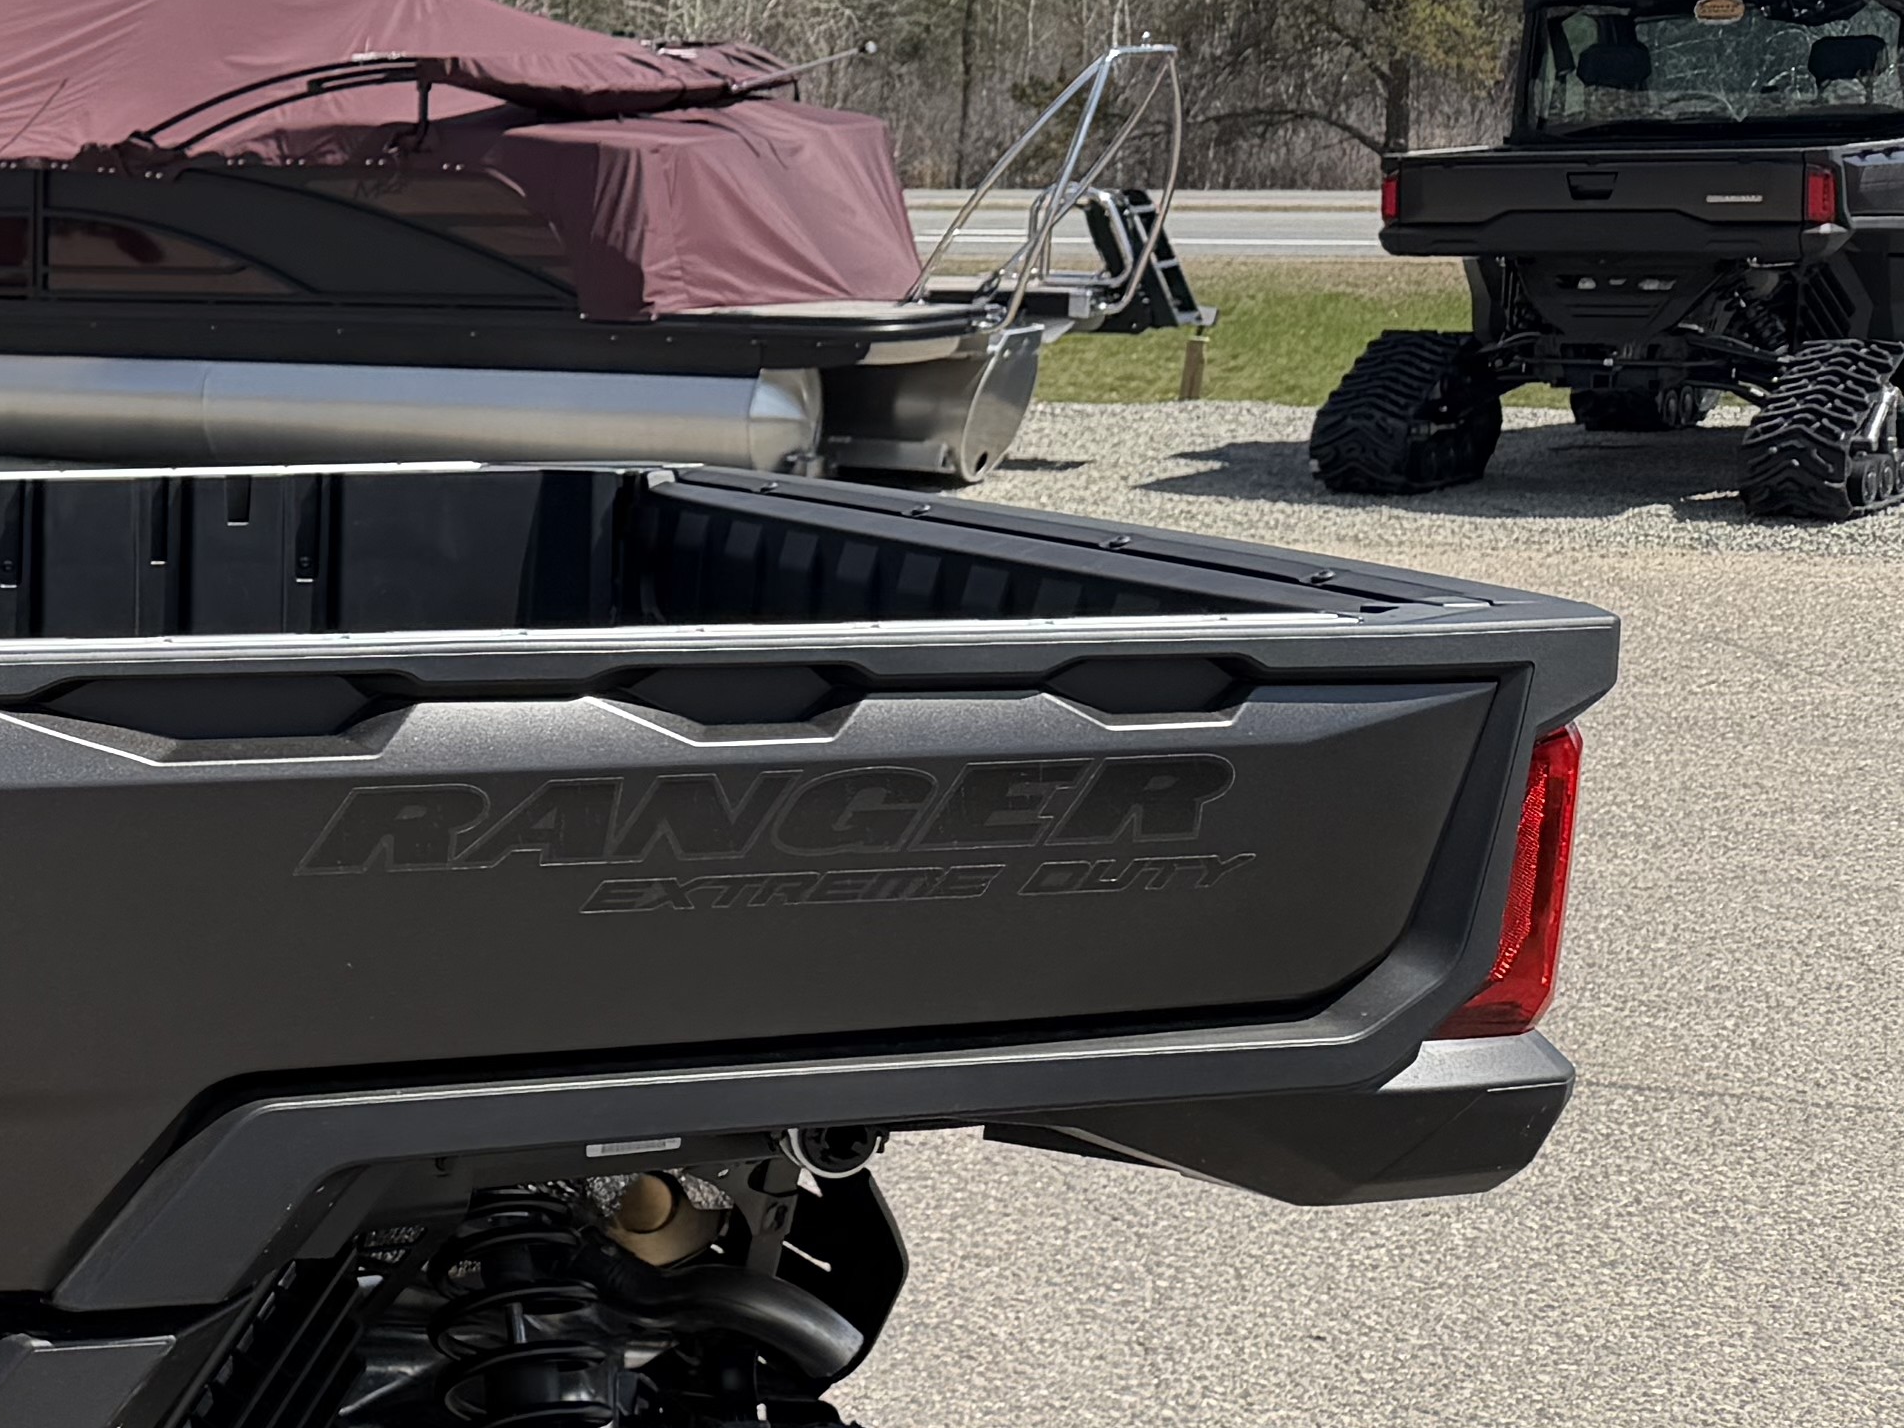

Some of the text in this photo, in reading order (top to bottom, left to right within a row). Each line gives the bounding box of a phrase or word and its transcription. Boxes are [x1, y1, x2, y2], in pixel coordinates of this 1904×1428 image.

[292, 753, 1237, 876] RANGER
[580, 852, 1257, 914] EXTREME DUTY
